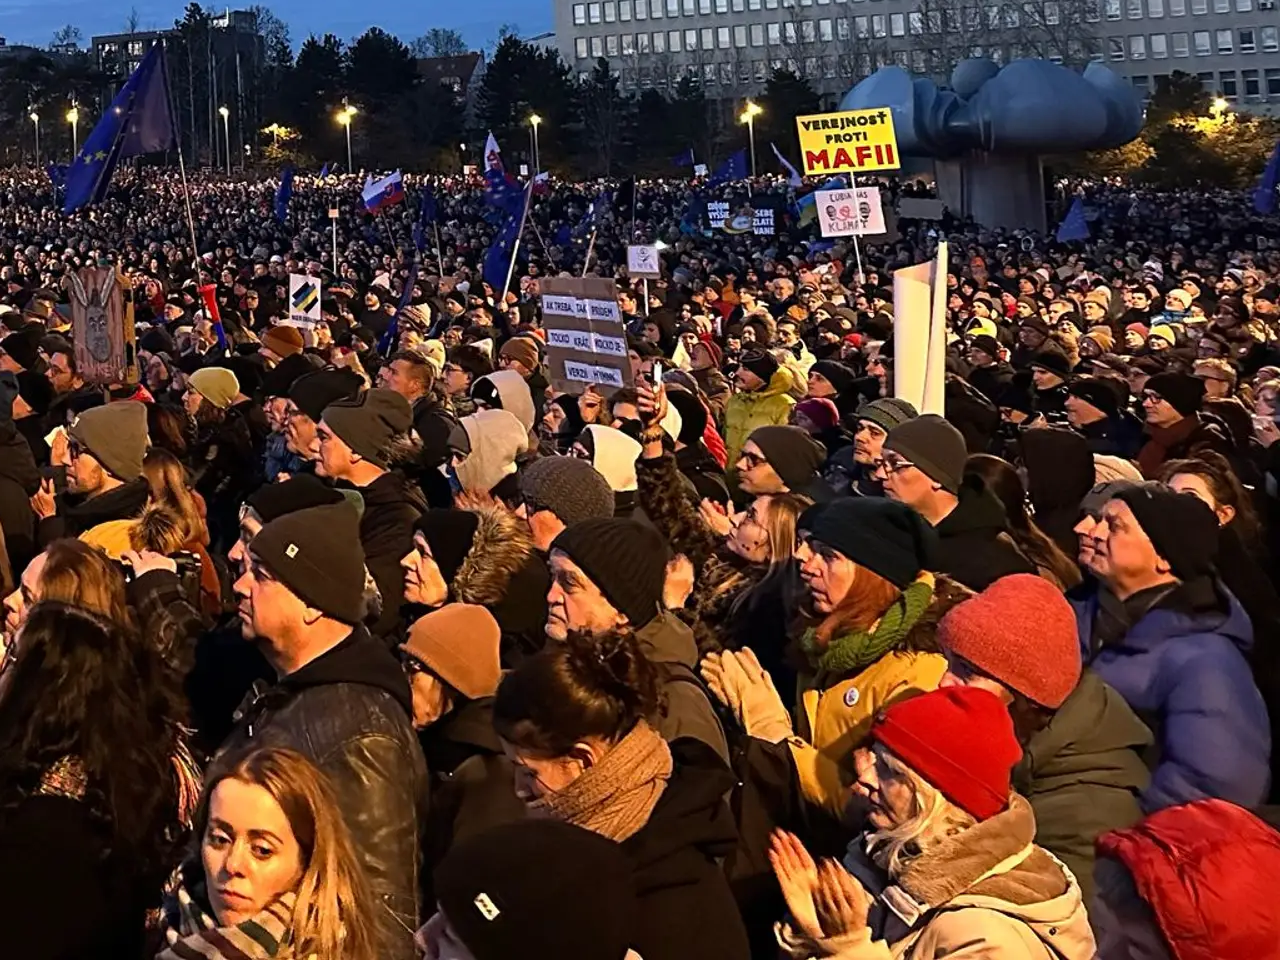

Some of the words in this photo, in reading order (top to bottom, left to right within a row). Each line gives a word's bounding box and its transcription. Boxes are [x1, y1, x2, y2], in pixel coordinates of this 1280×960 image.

[801, 111, 887, 131] VEREJNOSŤ
[825, 131, 868, 144] PROTI
[805, 144, 895, 171] MAFII
[546, 301, 554, 310] AK
[575, 303, 587, 313] TAK
